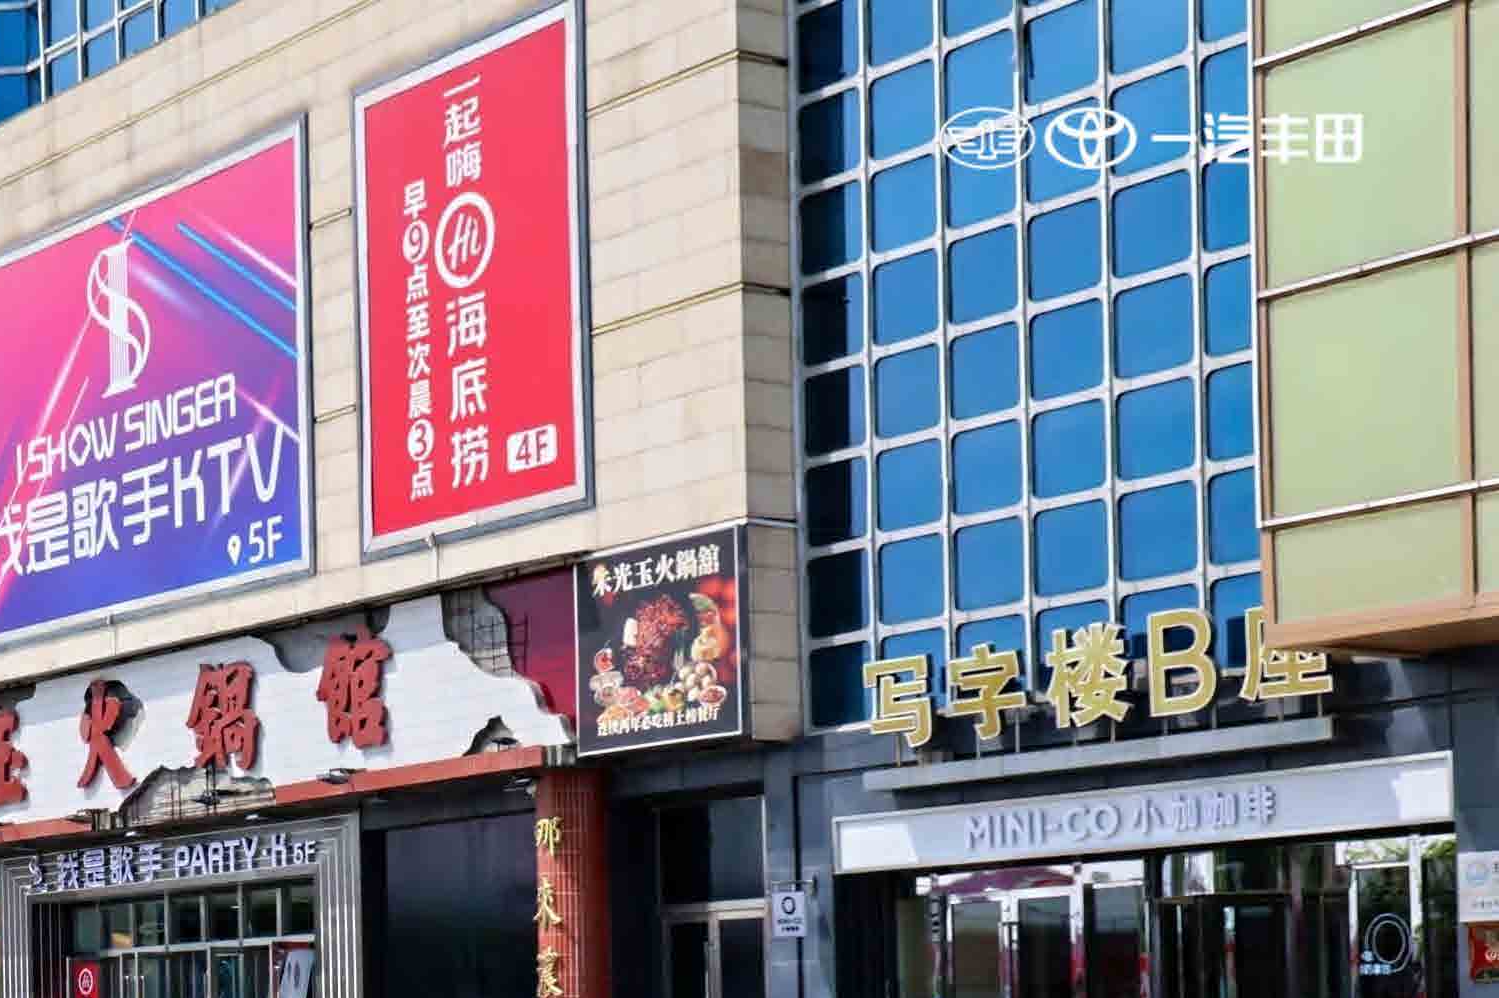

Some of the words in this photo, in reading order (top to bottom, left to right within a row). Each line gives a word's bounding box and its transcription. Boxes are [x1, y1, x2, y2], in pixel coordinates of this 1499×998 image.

[443, 73, 482, 188] 一起嗨
[124, 372, 237, 452] SINGER
[446, 291, 488, 489] 海底捞
[513, 427, 550, 468] 4F
[248, 515, 284, 564] 5F
[56, 842, 164, 890] 我是歌手
